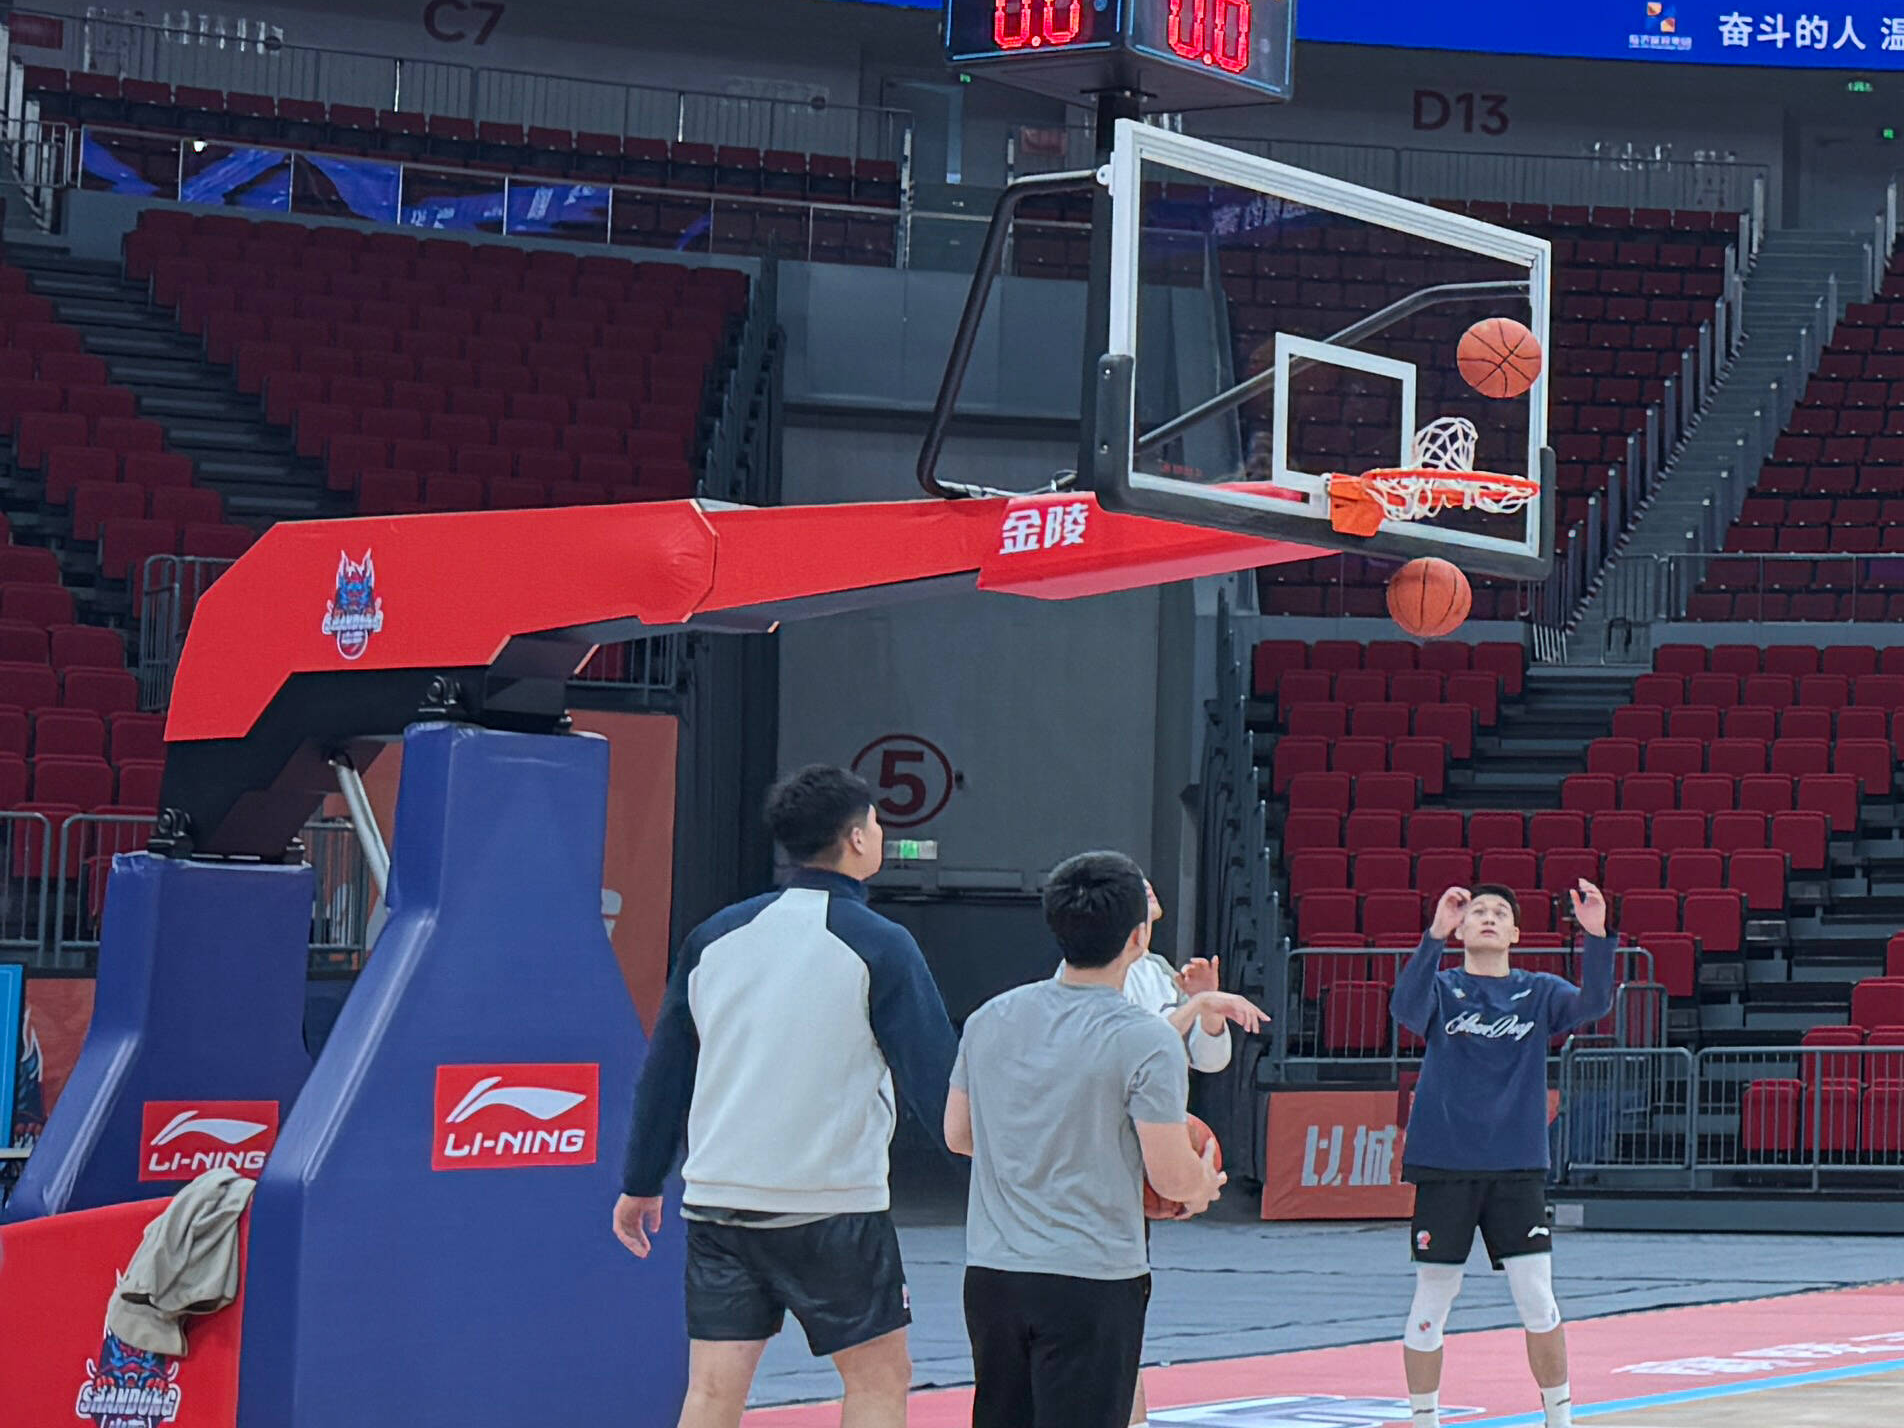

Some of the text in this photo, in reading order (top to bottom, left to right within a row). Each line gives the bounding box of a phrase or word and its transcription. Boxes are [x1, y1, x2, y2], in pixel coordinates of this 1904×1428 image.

[1718, 12, 1866, 52] 奋斗的人
[1413, 89, 1510, 135] D13
[999, 502, 1090, 555] 金陵
[877, 750, 927, 816] 5
[148, 1149, 267, 1173] LI-NING
[444, 1128, 586, 1158] LI-NING
